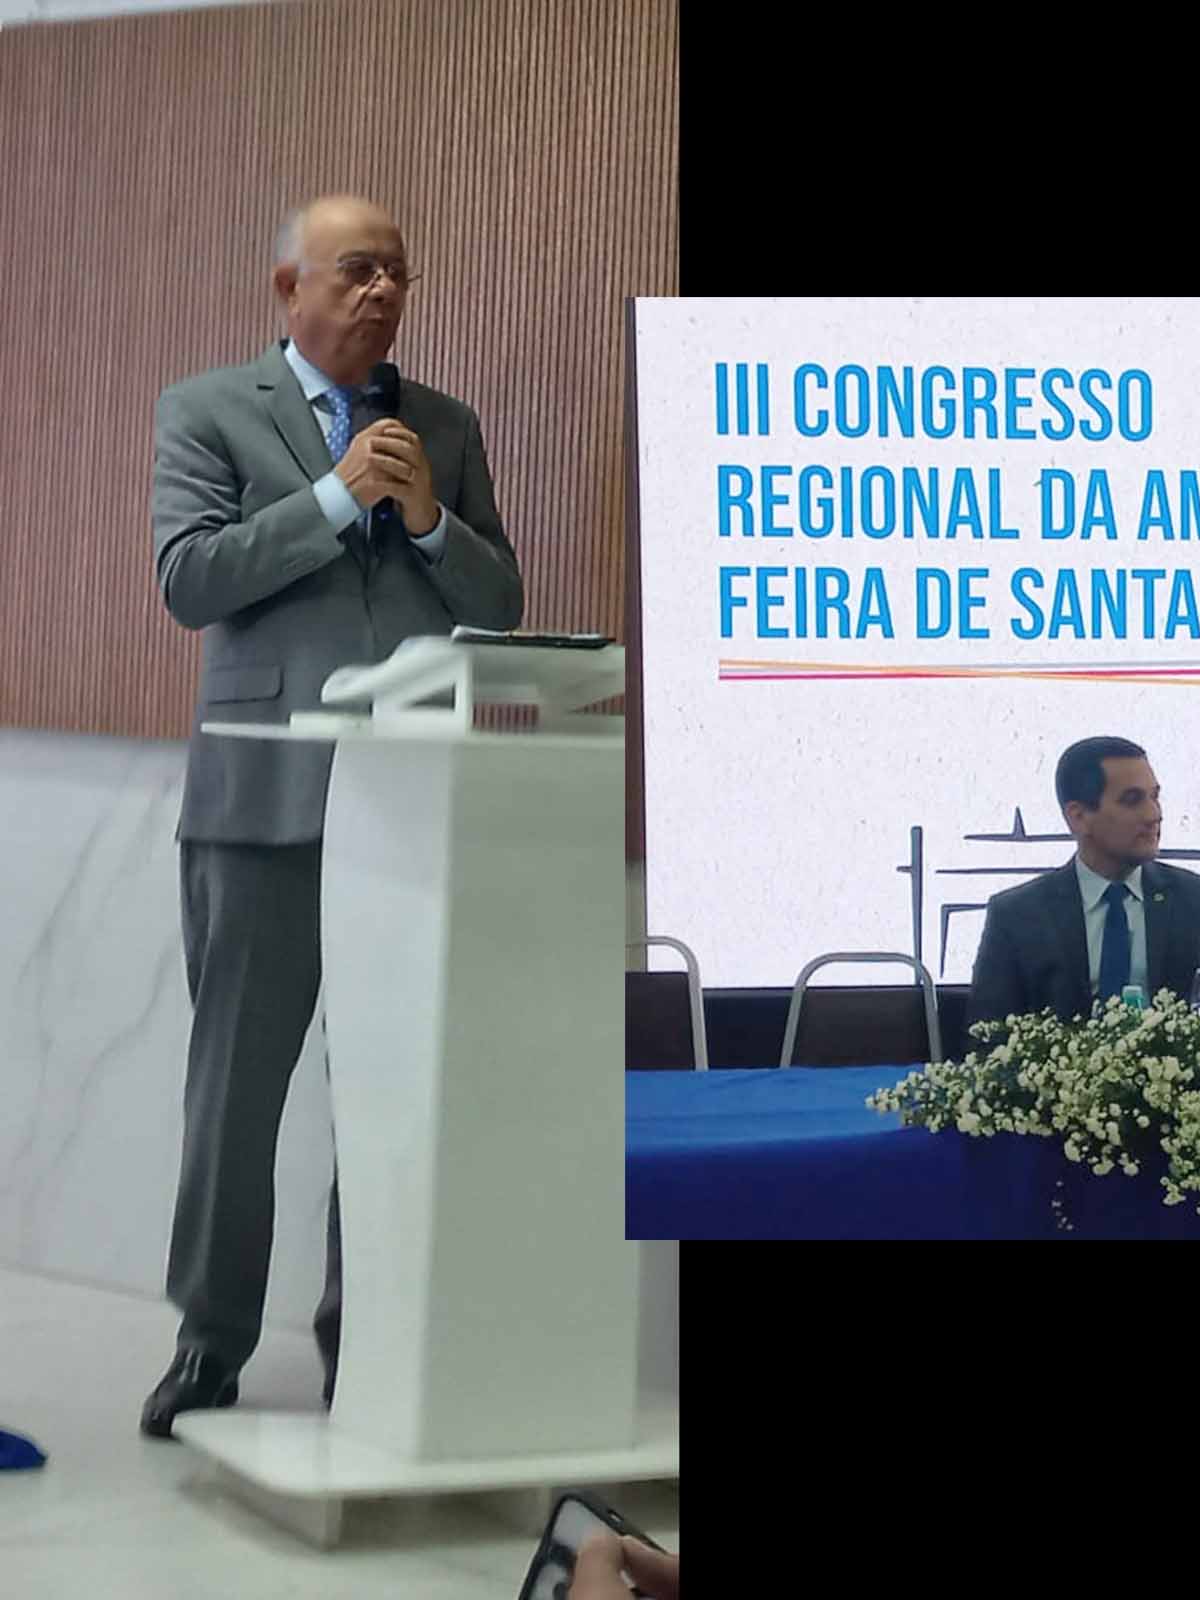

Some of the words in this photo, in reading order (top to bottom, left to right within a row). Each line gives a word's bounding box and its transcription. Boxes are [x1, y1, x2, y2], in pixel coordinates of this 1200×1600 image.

[715, 362, 770, 437] III
[793, 362, 1153, 442] CONGRESSO
[717, 464, 1020, 540] REGIONAL
[1039, 467, 1118, 541] DA
[719, 566, 895, 640] FEIRA
[915, 566, 991, 640] DE
